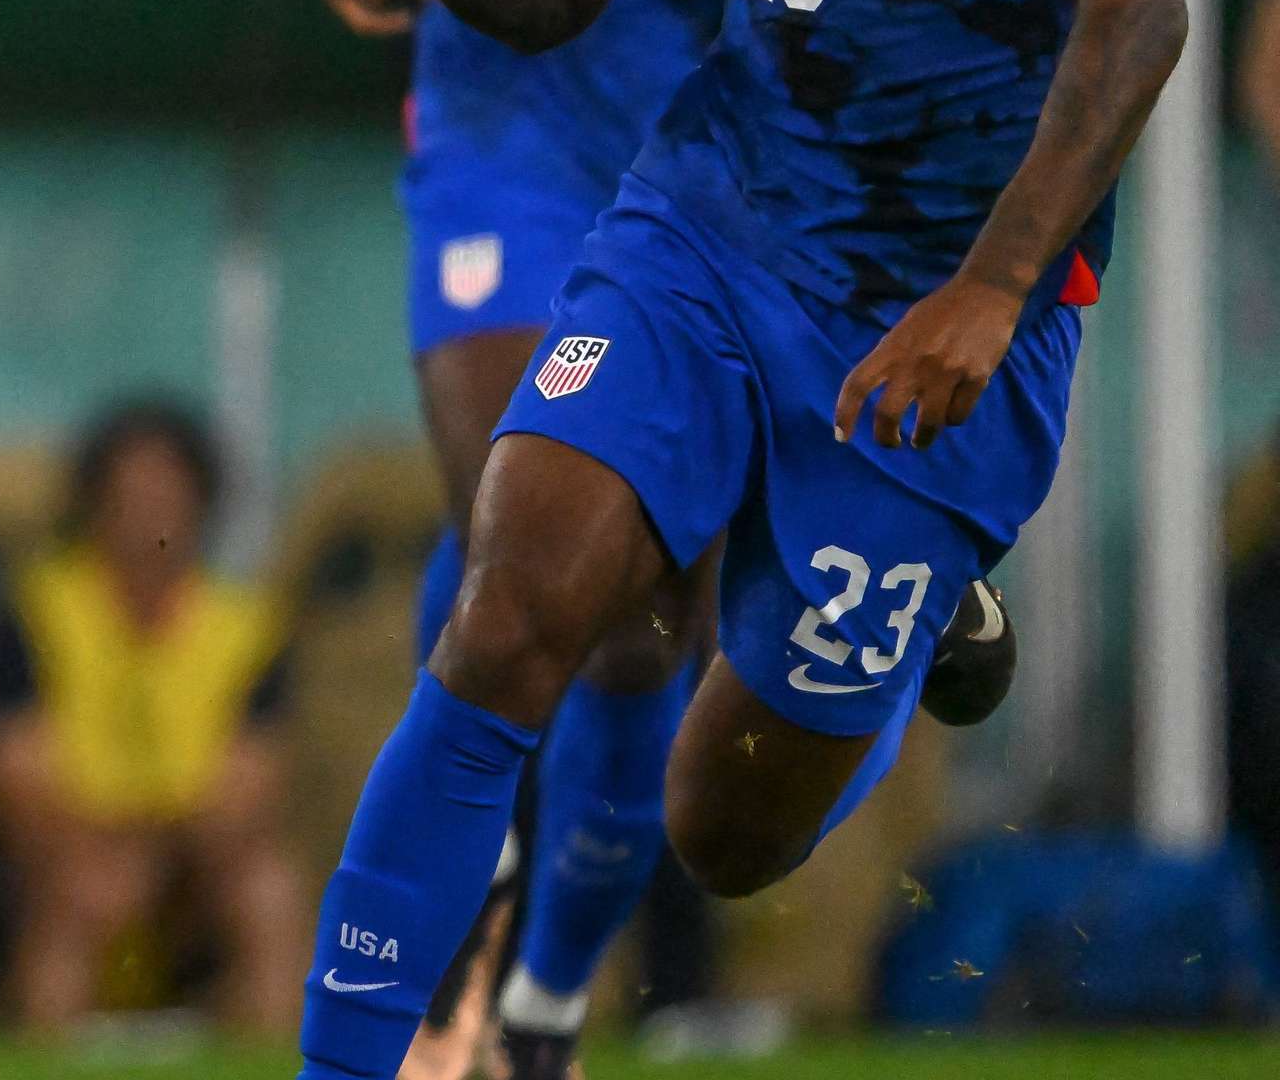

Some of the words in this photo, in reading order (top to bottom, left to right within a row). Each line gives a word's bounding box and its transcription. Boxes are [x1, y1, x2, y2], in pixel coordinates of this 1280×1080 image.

[556, 339, 606, 364] USA
[789, 544, 933, 674] 23
[340, 922, 399, 962] USA
